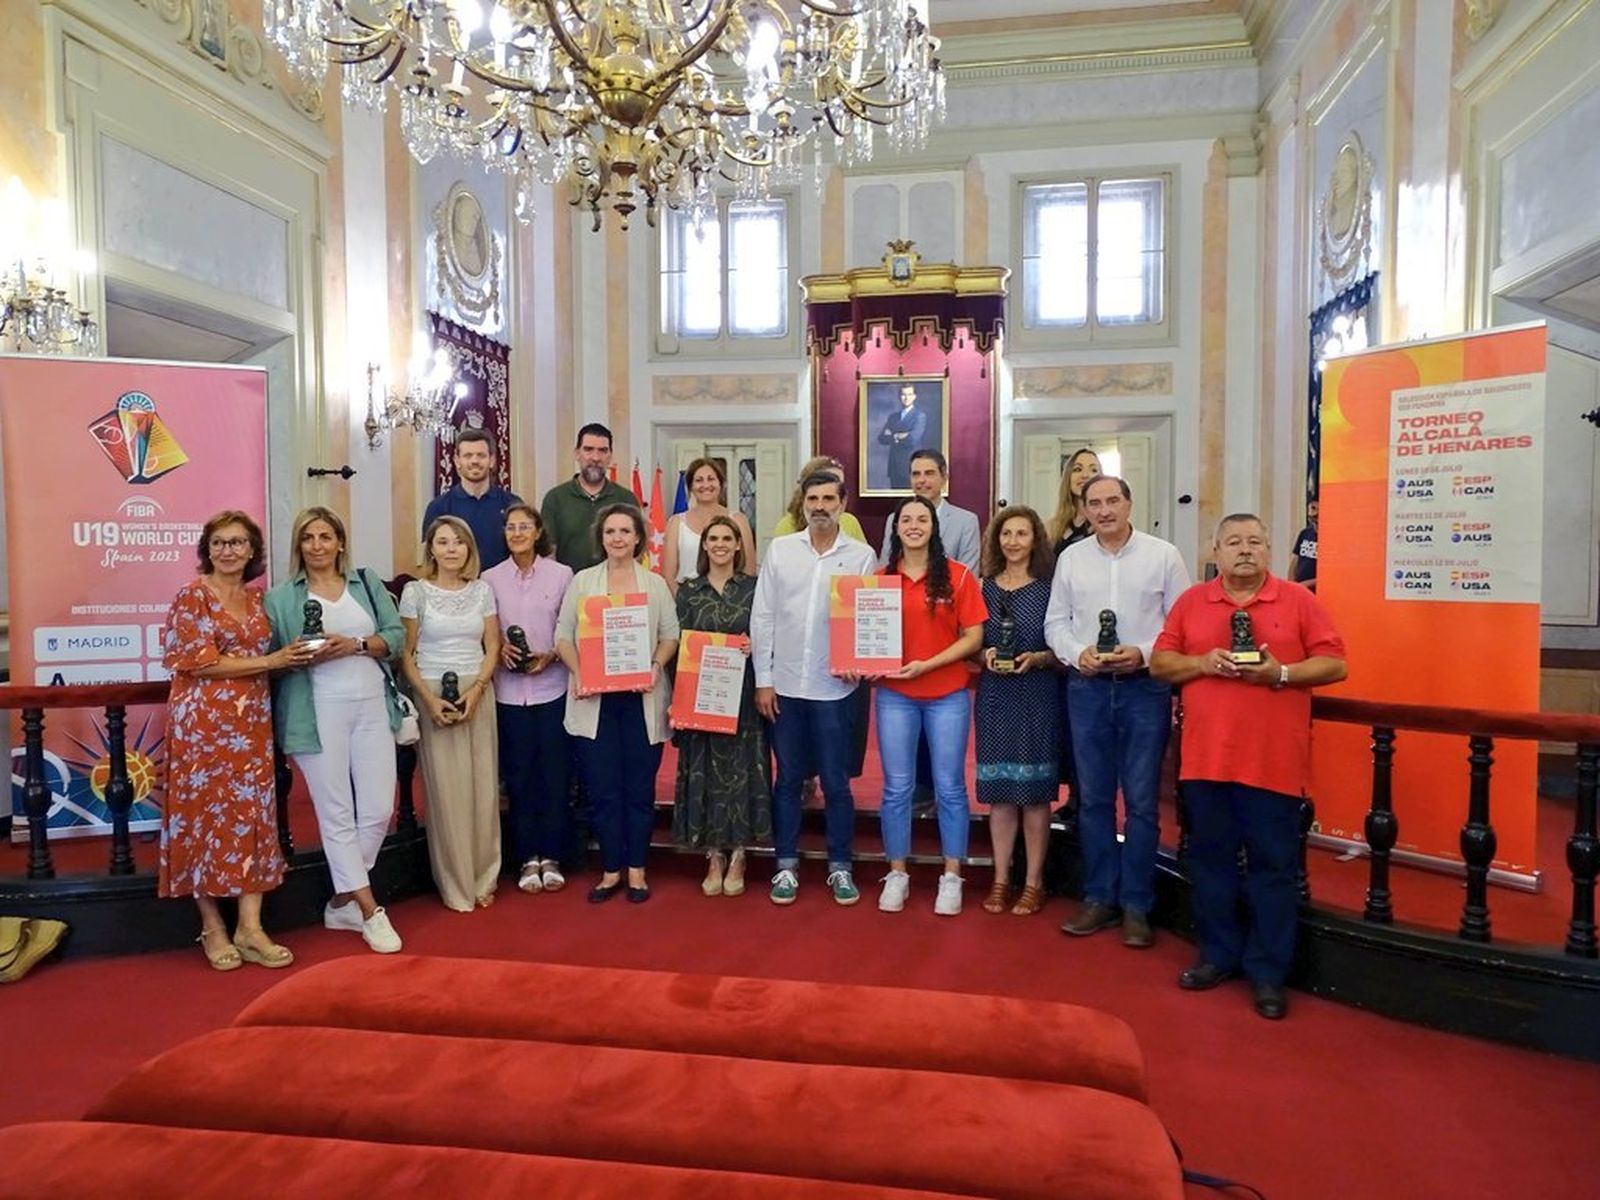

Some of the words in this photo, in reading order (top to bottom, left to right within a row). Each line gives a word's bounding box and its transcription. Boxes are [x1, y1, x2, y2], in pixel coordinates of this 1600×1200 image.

[1398, 411, 1484, 429] TORNEO
[1397, 424, 1482, 443] ALCALÁ
[1397, 444, 1423, 457] DE
[1428, 436, 1532, 454] HENARES
[1407, 479, 1434, 487] AUS
[1464, 476, 1492, 485] ESP
[1407, 489, 1434, 498] USA
[1464, 486, 1494, 495] CAN
[126, 505, 155, 517] FIBA
[1405, 525, 1434, 533] CAN
[1463, 523, 1491, 531] ESP
[73, 521, 119, 547] U19
[122, 531, 173, 545] WORLD
[1463, 533, 1492, 541] AUS
[1405, 535, 1433, 543] USA
[100, 548, 144, 569] Spain
[149, 550, 180, 562] 2023
[1405, 571, 1431, 579] AUS
[1462, 571, 1490, 579] ESP
[1462, 582, 1491, 590] USA
[68, 637, 130, 648] MADRID
